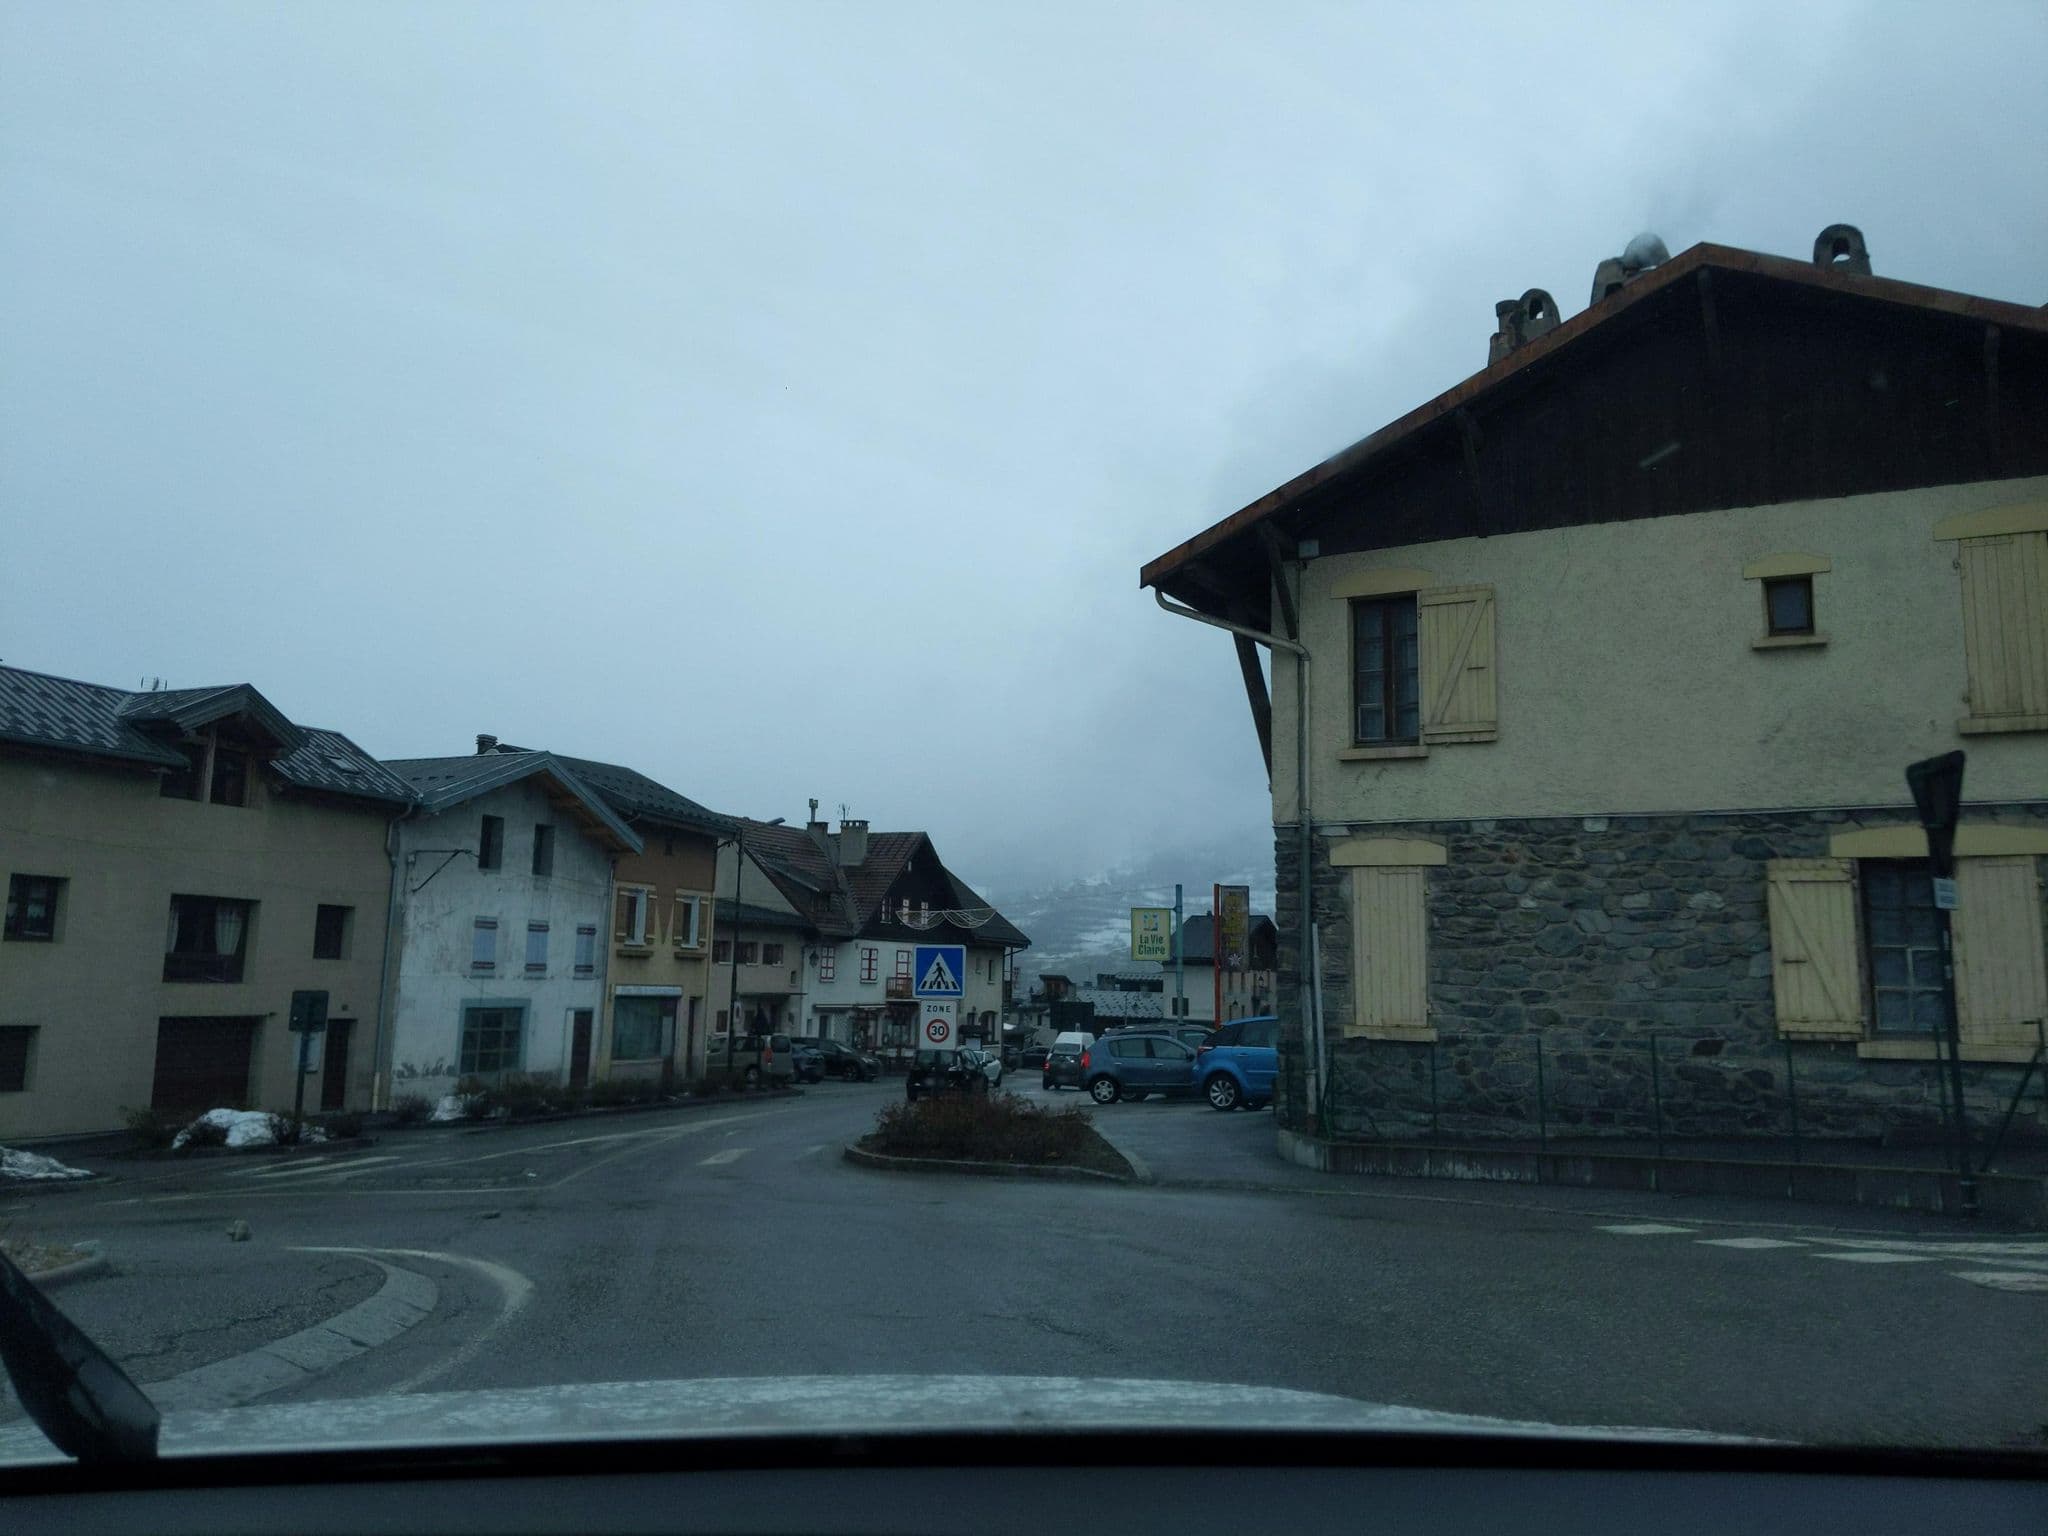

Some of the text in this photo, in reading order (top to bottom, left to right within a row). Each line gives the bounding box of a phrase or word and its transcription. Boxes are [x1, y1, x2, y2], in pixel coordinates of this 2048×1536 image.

[1139, 934, 1164, 944] La Vie
[1138, 944, 1166, 955] Claire
[926, 1005, 951, 1013] ZONE
[931, 1026, 945, 1036] 30
